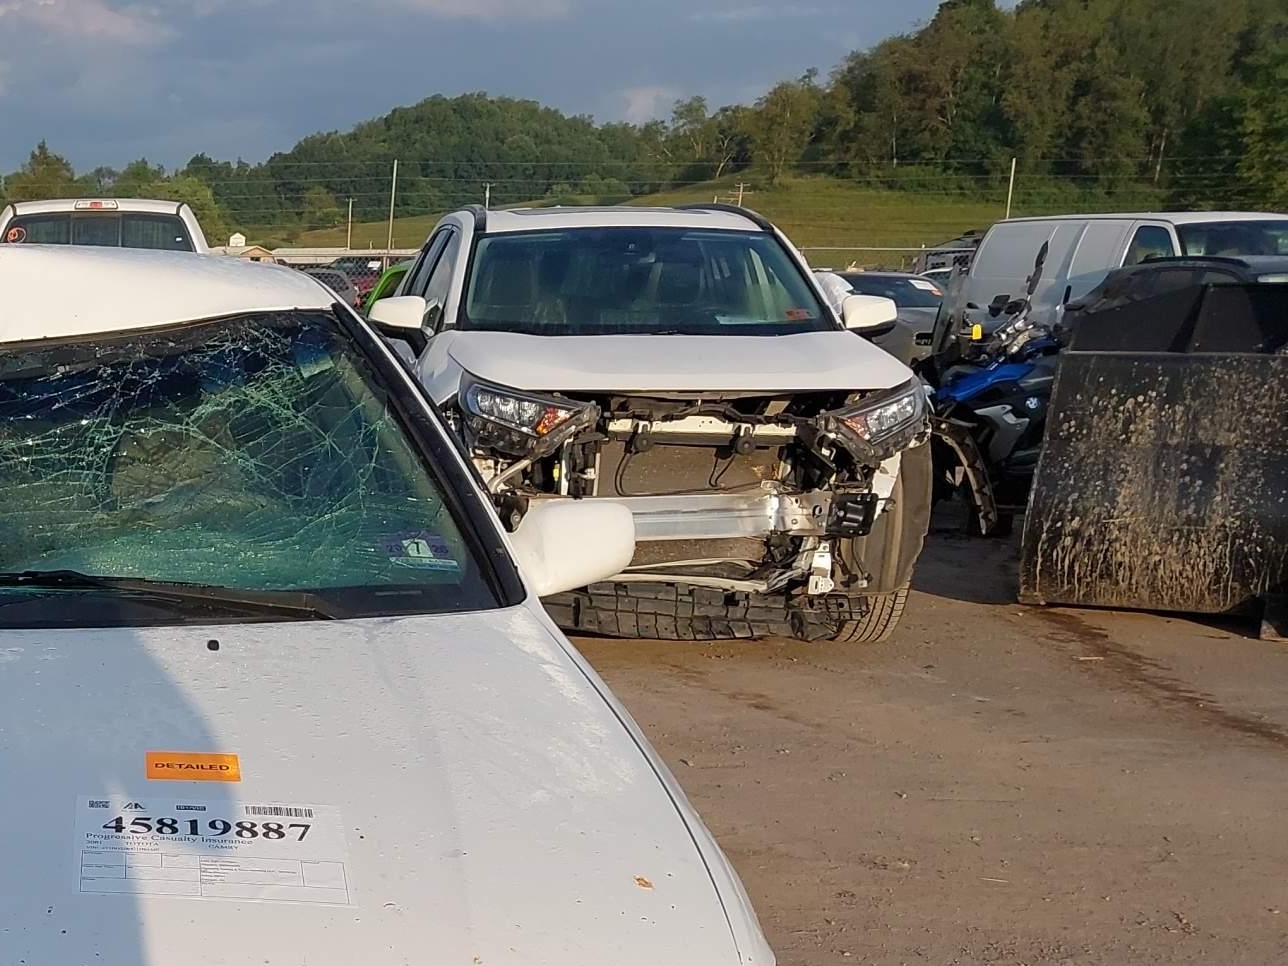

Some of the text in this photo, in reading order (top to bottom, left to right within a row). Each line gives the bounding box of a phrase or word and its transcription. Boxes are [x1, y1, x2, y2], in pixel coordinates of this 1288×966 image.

[155, 762, 231, 771] DETAILED
[102, 815, 312, 842] 45819887
[86, 832, 254, 845] Progressive Casualty Insurance
